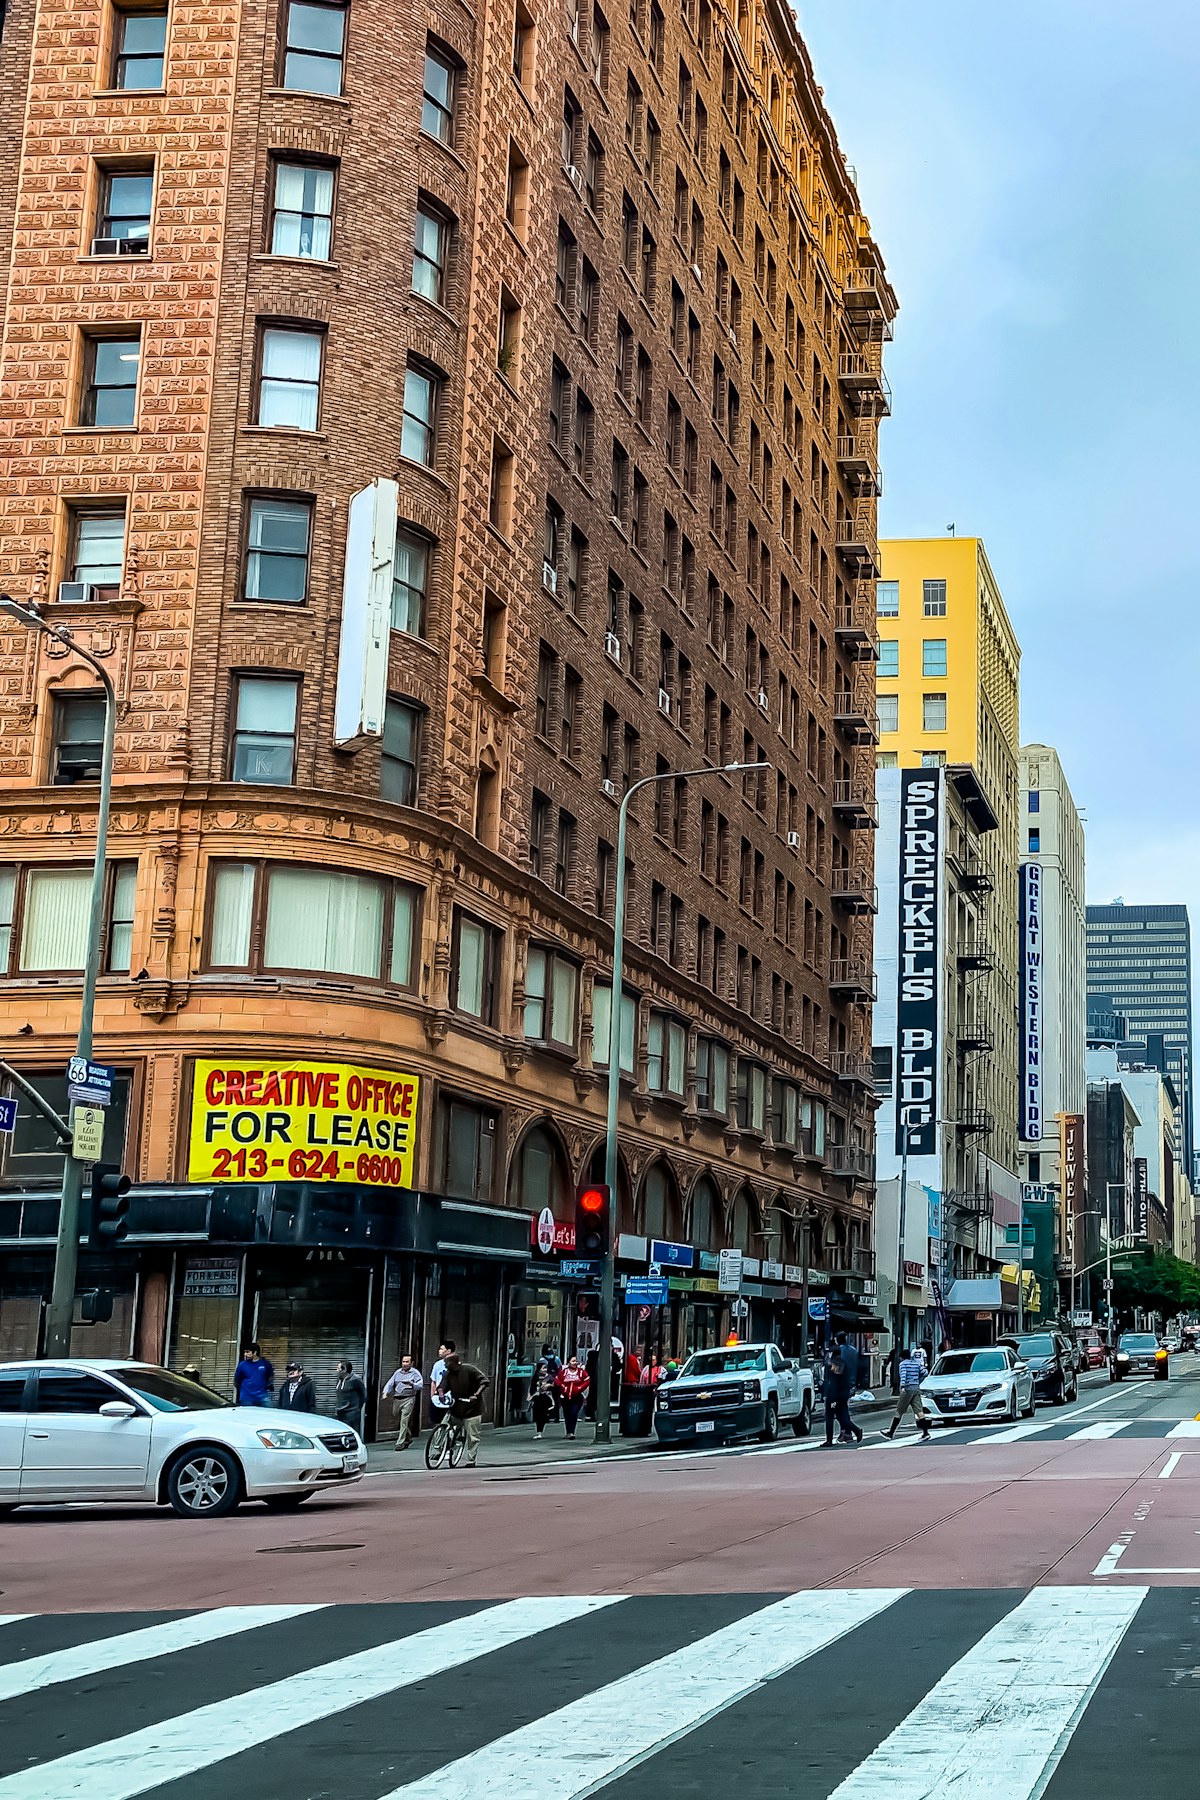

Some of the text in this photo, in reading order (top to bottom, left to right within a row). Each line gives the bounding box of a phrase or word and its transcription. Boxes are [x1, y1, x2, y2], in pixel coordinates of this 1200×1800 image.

[902, 781, 935, 1002] SPRECKELS
[1027, 866, 1040, 1138] GREAT WESTERN BLDG
[71, 1065, 84, 1081] 66
[205, 1069, 414, 1118] CREATIVE OFFICE
[205, 1111, 409, 1153] FOR LEASE
[1065, 1129, 1076, 1250] JEWELRY
[527, 1320, 561, 1329] frozen
[527, 1328, 540, 1338] fix
